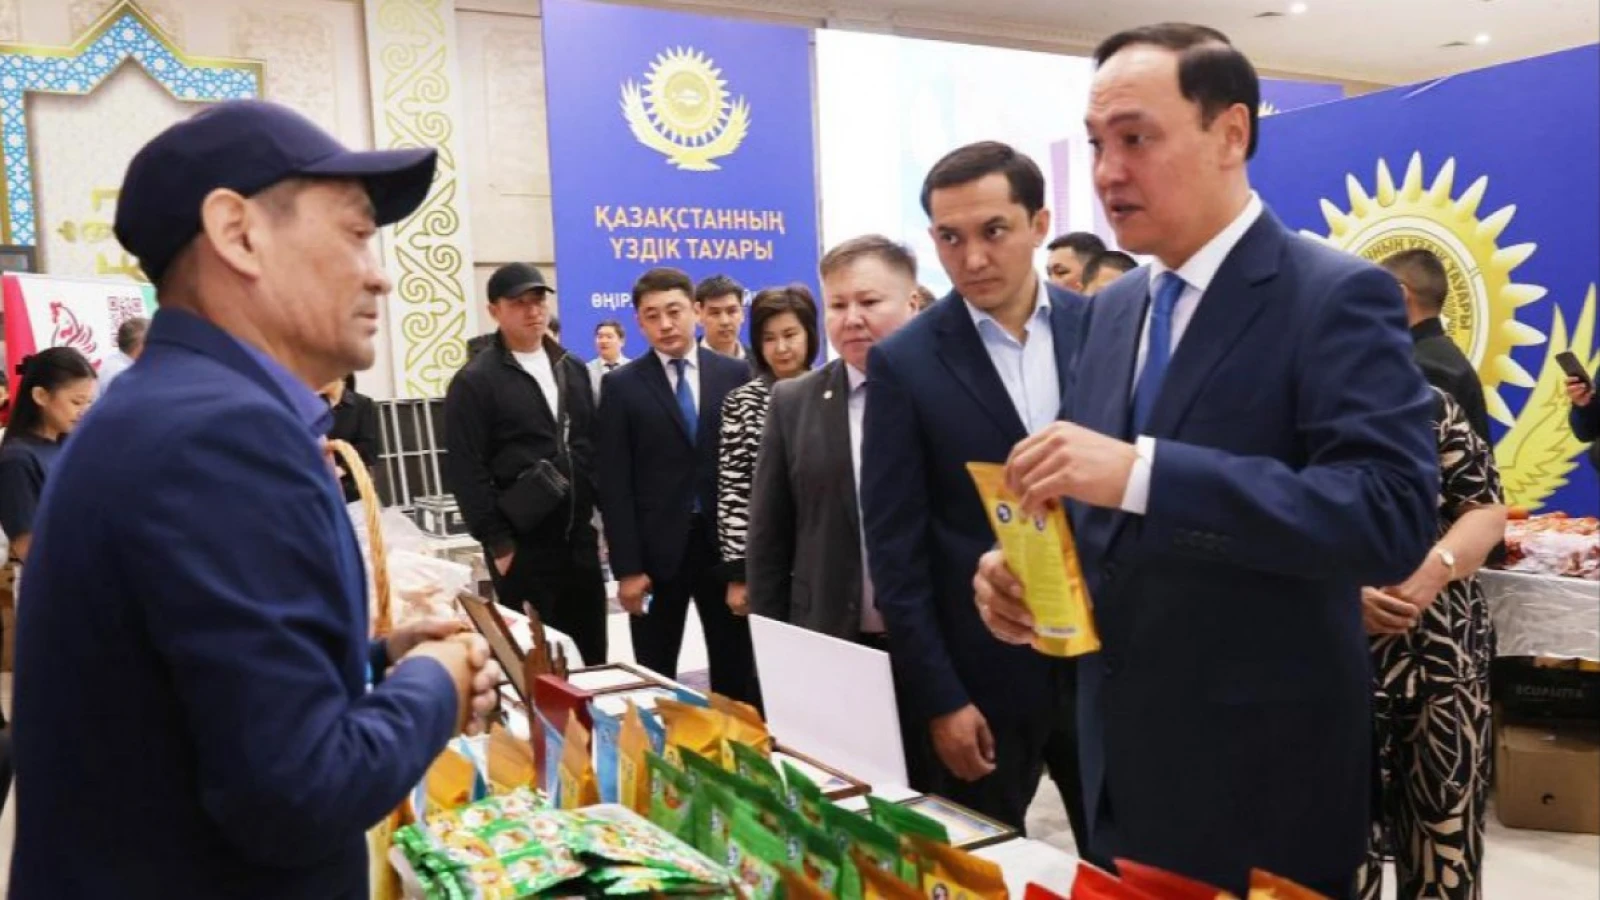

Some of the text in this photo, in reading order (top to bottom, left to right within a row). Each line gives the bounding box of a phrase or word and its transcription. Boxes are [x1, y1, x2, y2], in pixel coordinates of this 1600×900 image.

[594, 205, 786, 235] ҚАЗАҚСТАННЫҢ
[609, 237, 773, 263] ҮЗДІК ТАУАРЫ
[591, 291, 634, 311] ӨҢІР
